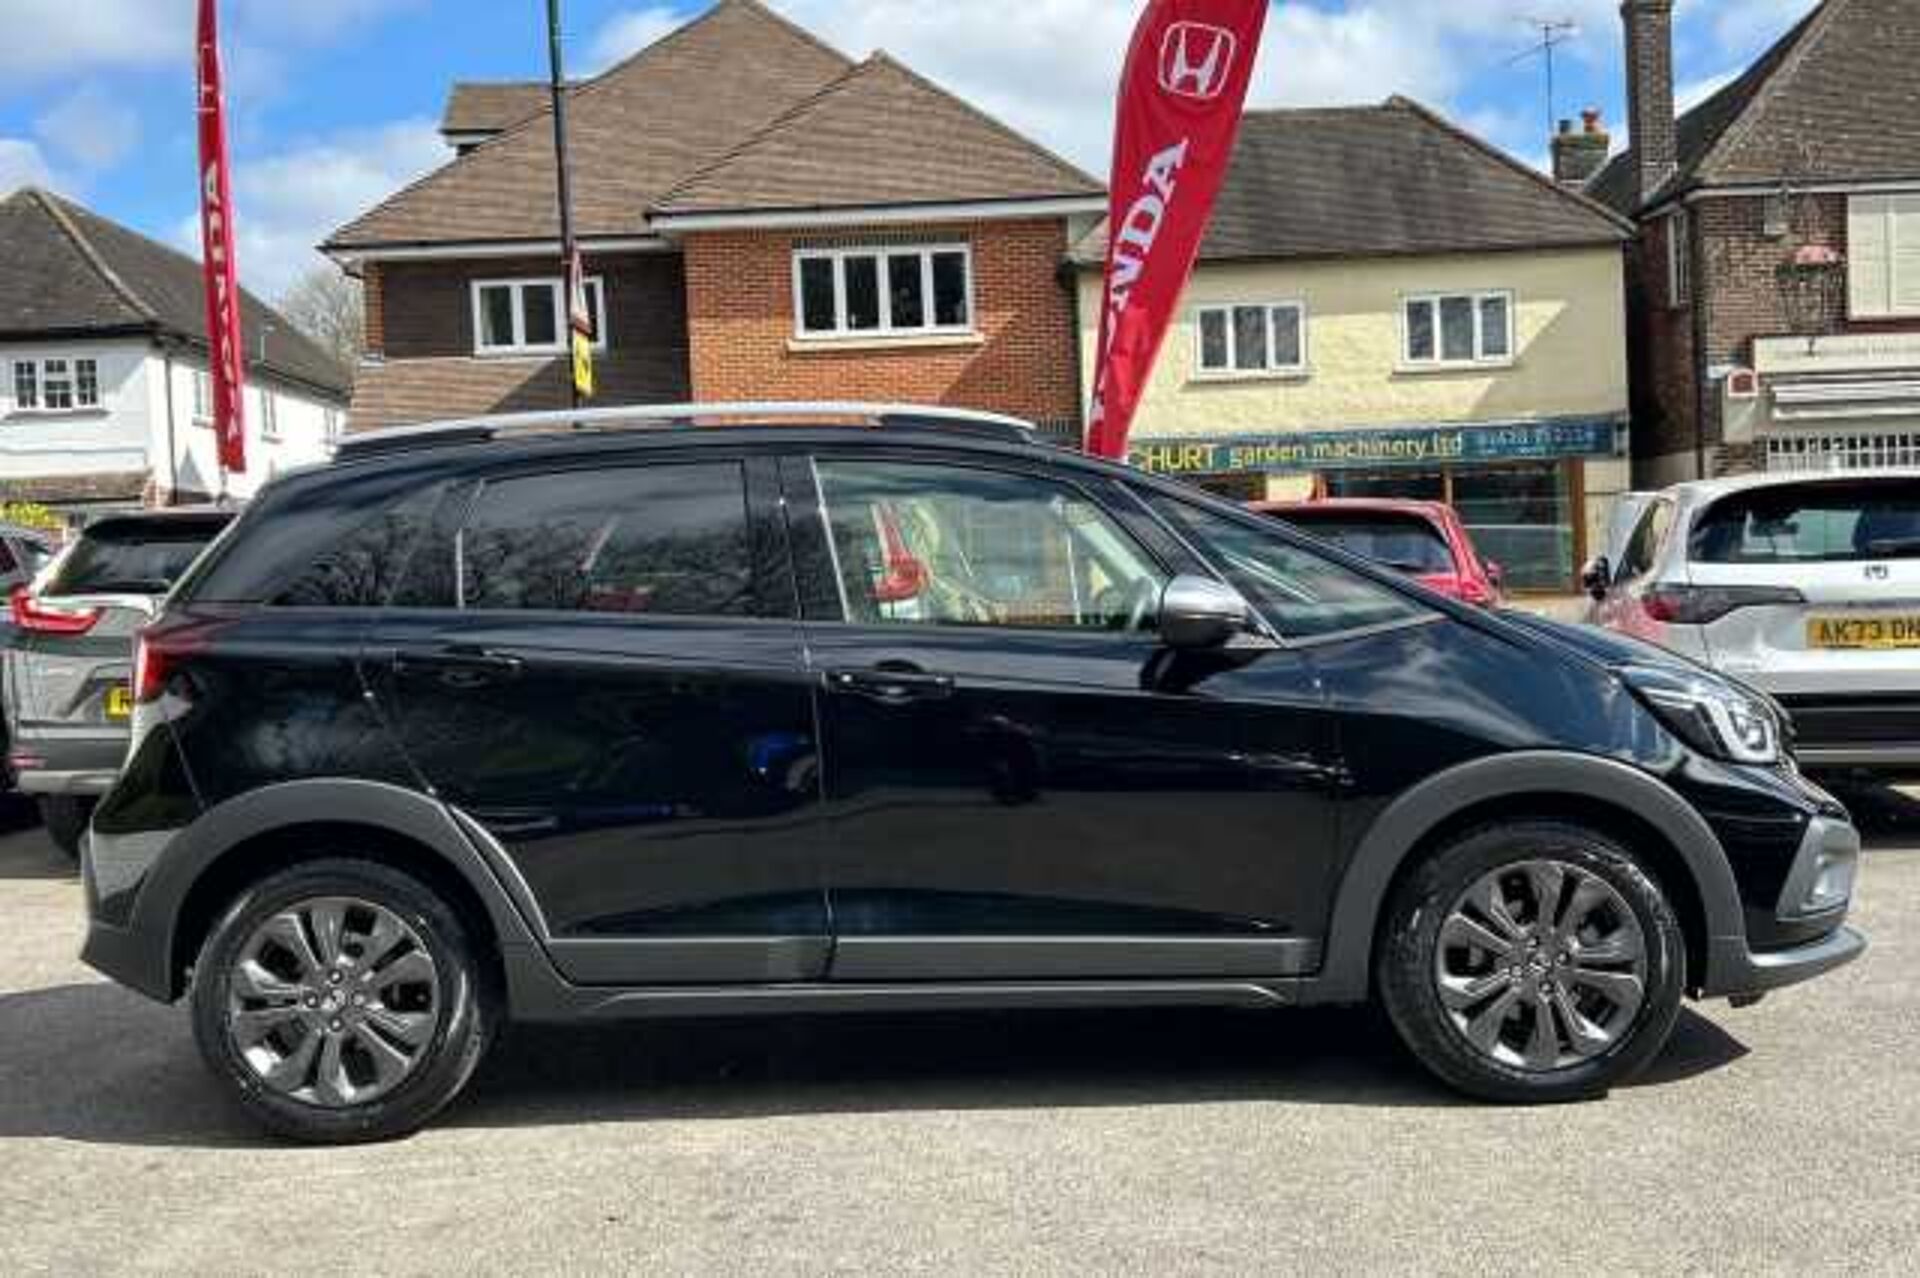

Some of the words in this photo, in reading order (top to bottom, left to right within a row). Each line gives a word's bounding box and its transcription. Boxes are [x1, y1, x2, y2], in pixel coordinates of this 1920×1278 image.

[1229, 443, 1306, 469] garden
[1313, 435, 1427, 460] machinery
[1821, 618, 1882, 643] AK73
